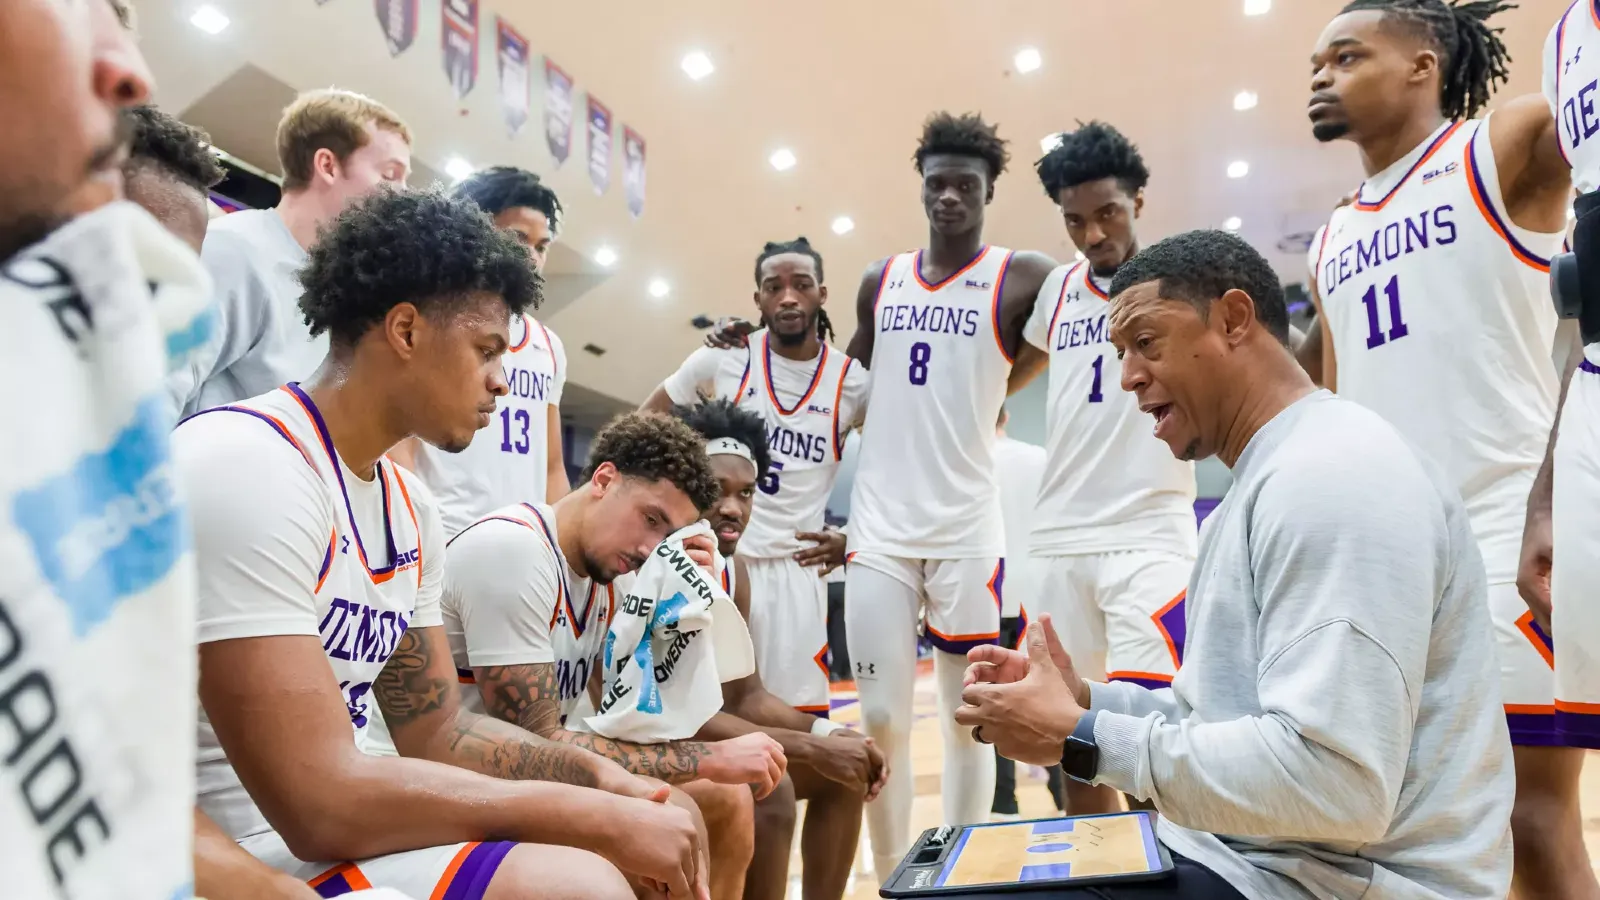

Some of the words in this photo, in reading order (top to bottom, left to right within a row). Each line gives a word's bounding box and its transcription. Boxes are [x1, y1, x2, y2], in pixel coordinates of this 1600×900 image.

[1325, 205, 1456, 295] DEMONS
[881, 305, 979, 337] DEMONS
[1362, 275, 1409, 350] 11
[909, 342, 931, 385] 8
[1088, 355, 1103, 402] 1
[500, 406, 530, 454] 13
[757, 460, 784, 495] 5
